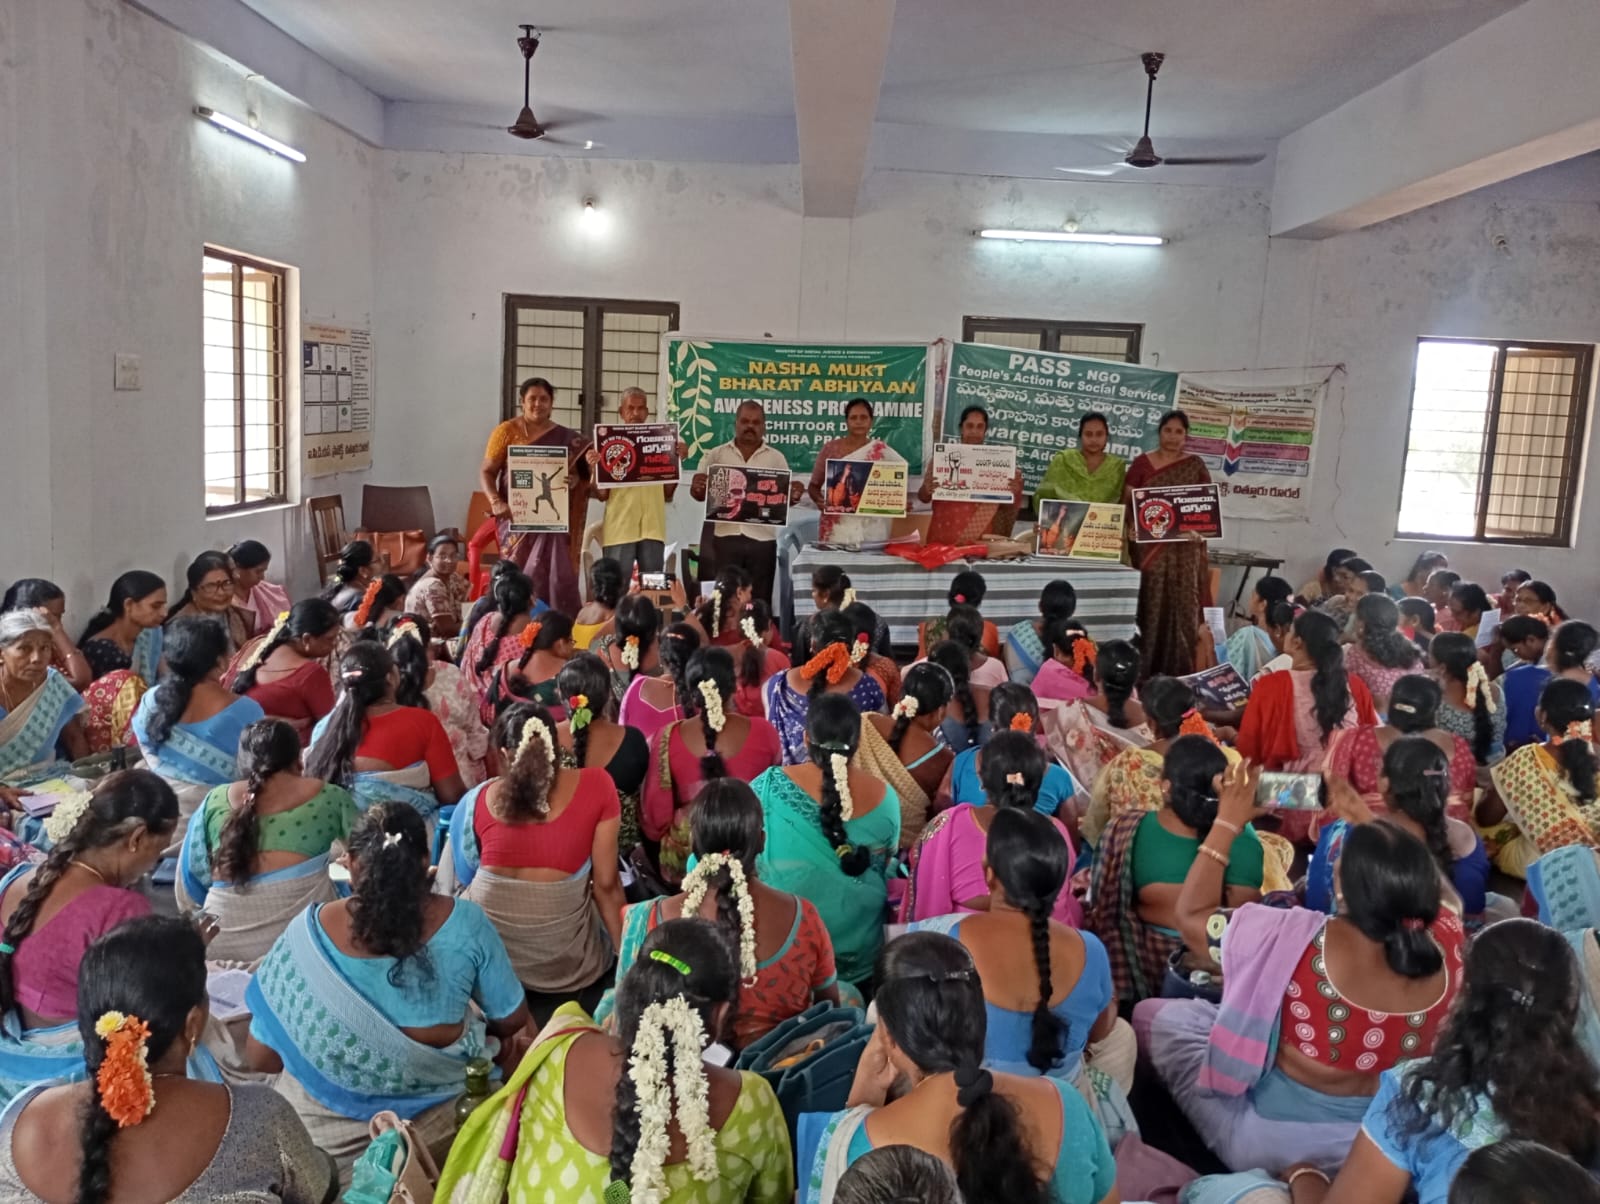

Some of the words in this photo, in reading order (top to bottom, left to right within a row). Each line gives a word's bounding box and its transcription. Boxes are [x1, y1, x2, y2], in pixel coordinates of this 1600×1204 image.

[748, 361, 821, 376] NASHA
[827, 363, 888, 377] MUKT
[1009, 353, 1071, 377] PASS
[1087, 369, 1121, 384] NGO
[719, 377, 803, 391] BHARAT
[809, 379, 916, 394] ABHIYAAN
[958, 364, 1010, 381] People's
[1013, 372, 1053, 387] Action
[1057, 378, 1075, 390] for
[1077, 381, 1116, 395] Social
[1119, 386, 1166, 402] Service
[713, 398, 813, 416] AWENESS
[1034, 392, 1075, 413] మత్తు
[764, 420, 836, 432] CHITTOOR
